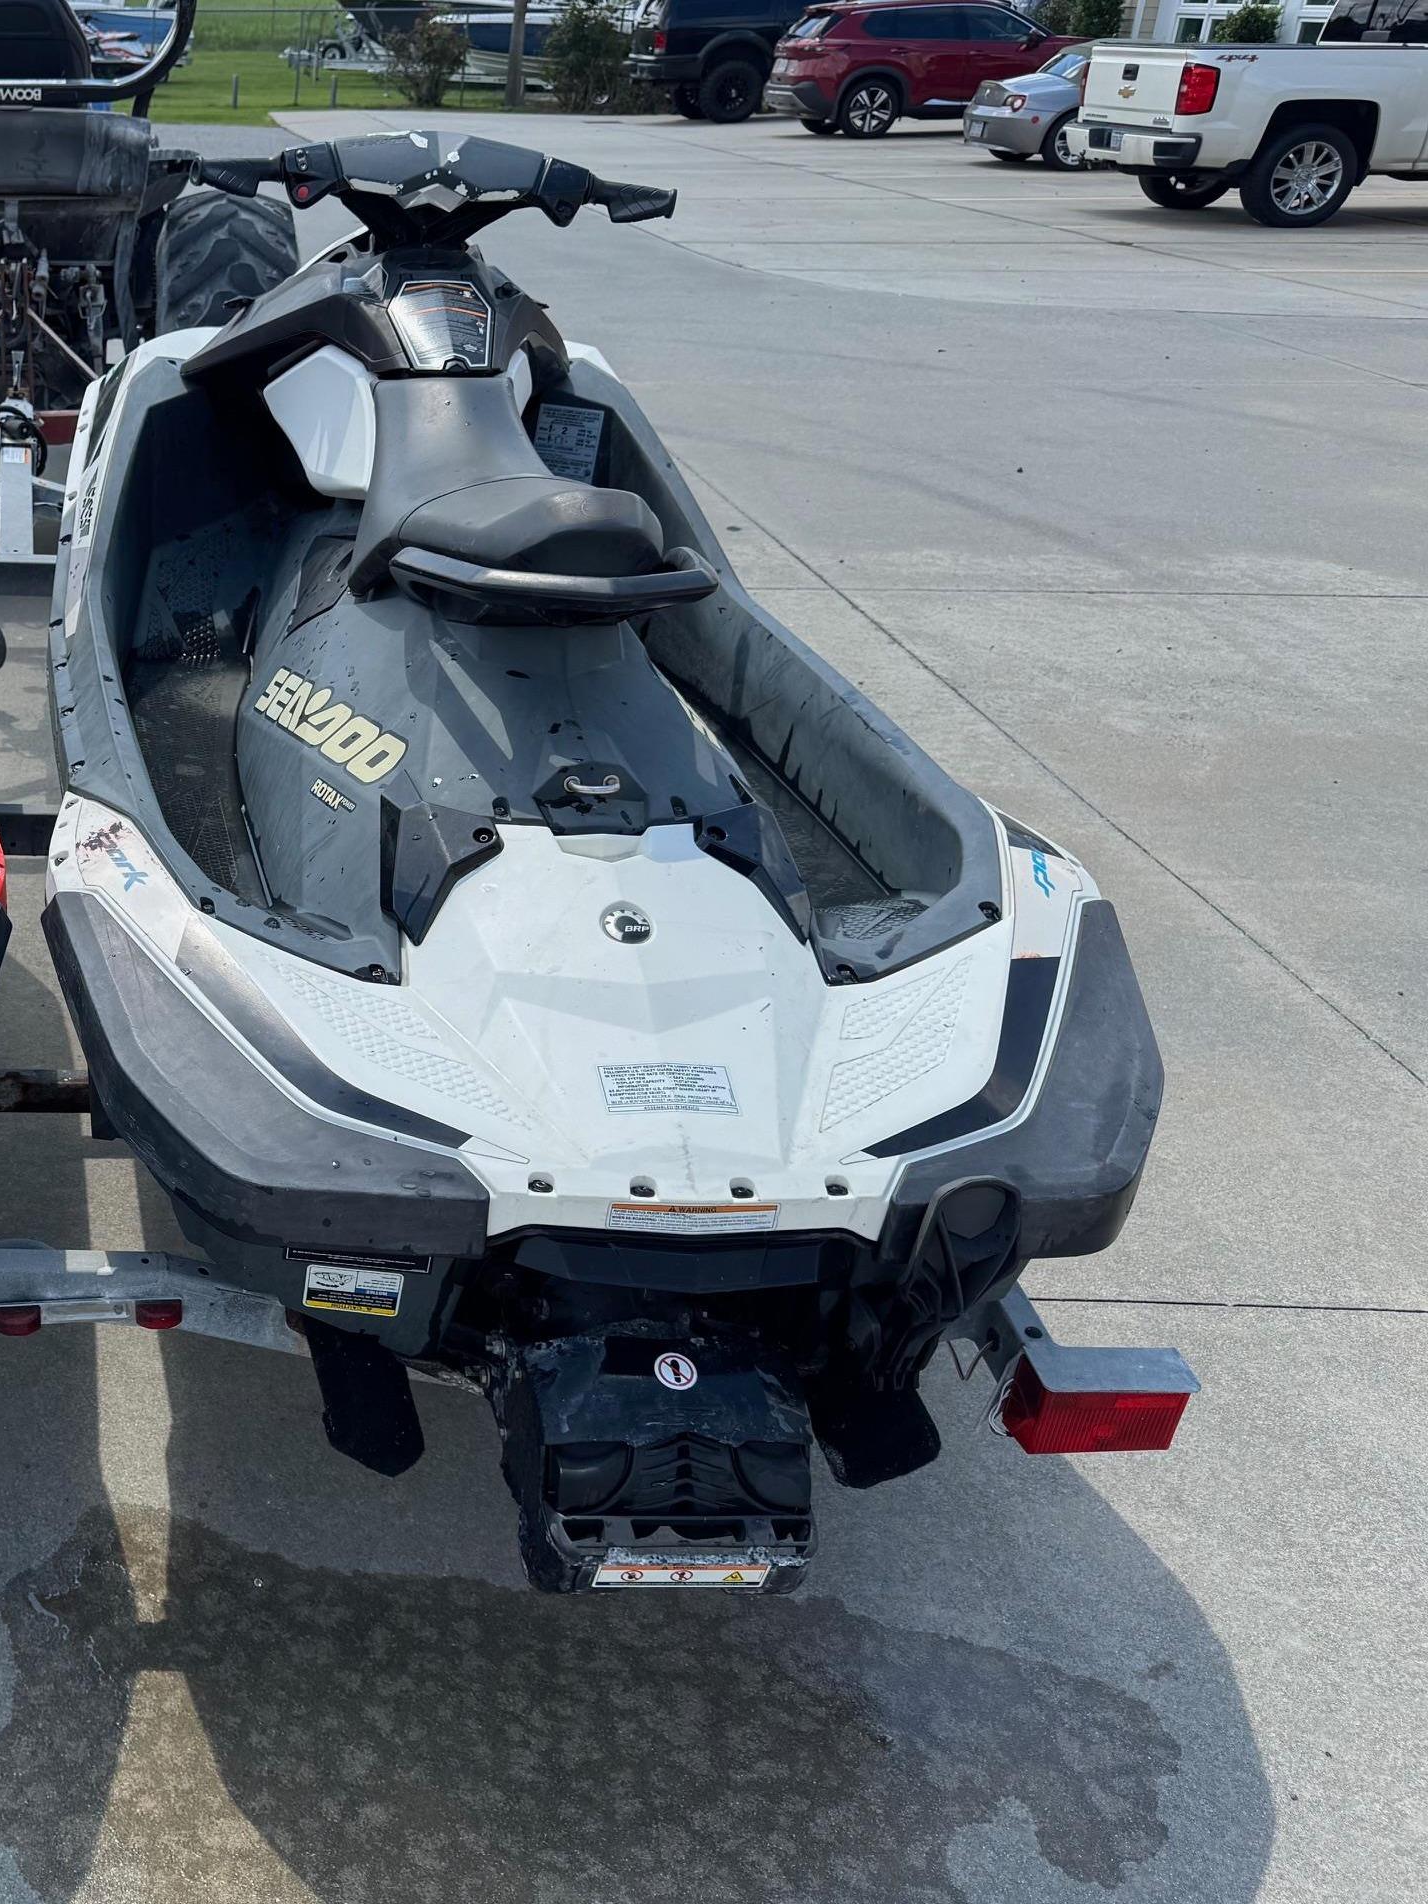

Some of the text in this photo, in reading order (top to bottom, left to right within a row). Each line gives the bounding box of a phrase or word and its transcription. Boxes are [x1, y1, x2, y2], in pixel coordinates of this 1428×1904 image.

[311, 778, 342, 809] ROTAX
[624, 925, 650, 933] BRP
[678, 1206, 717, 1214] WARNING
